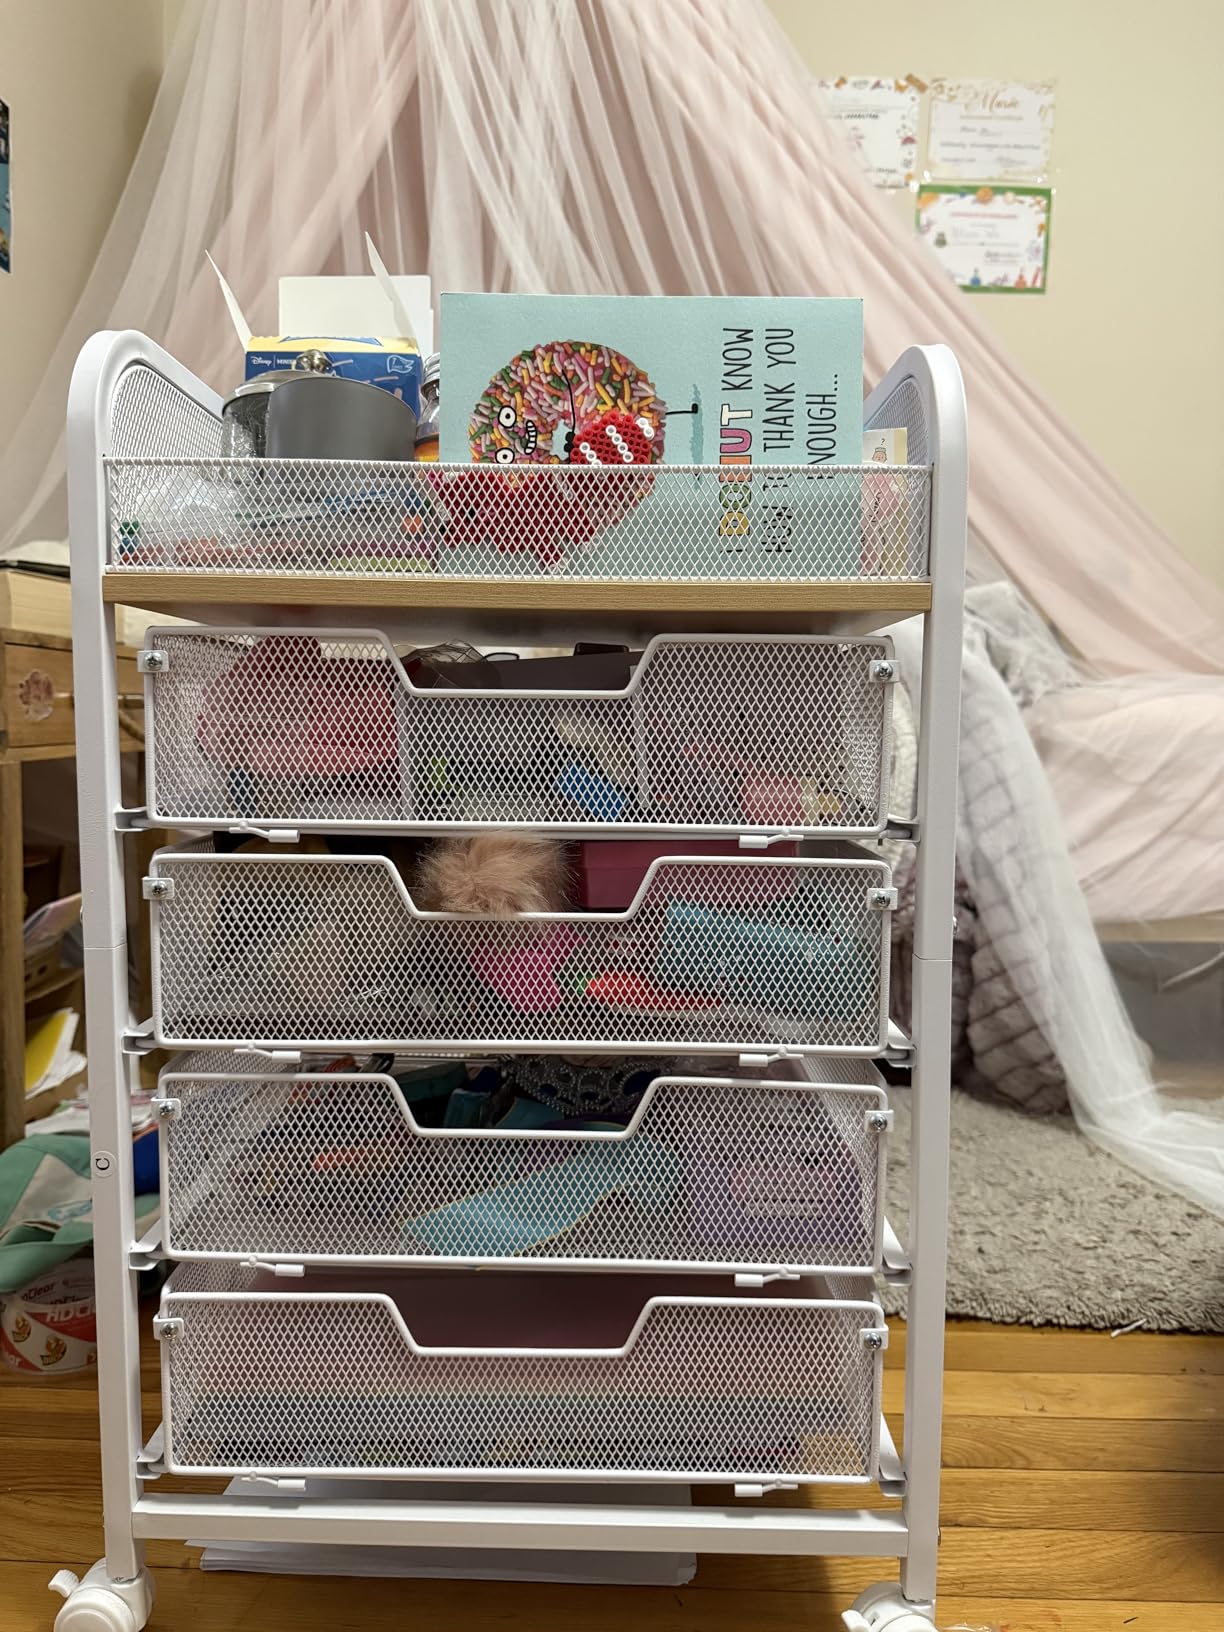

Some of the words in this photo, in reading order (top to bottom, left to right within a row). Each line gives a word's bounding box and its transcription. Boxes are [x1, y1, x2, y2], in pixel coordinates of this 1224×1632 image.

[721, 327, 754, 391] KNOW
[764, 328, 797, 369] YOU
[762, 382, 796, 452] THANK
[761, 505, 793, 553] HOW
